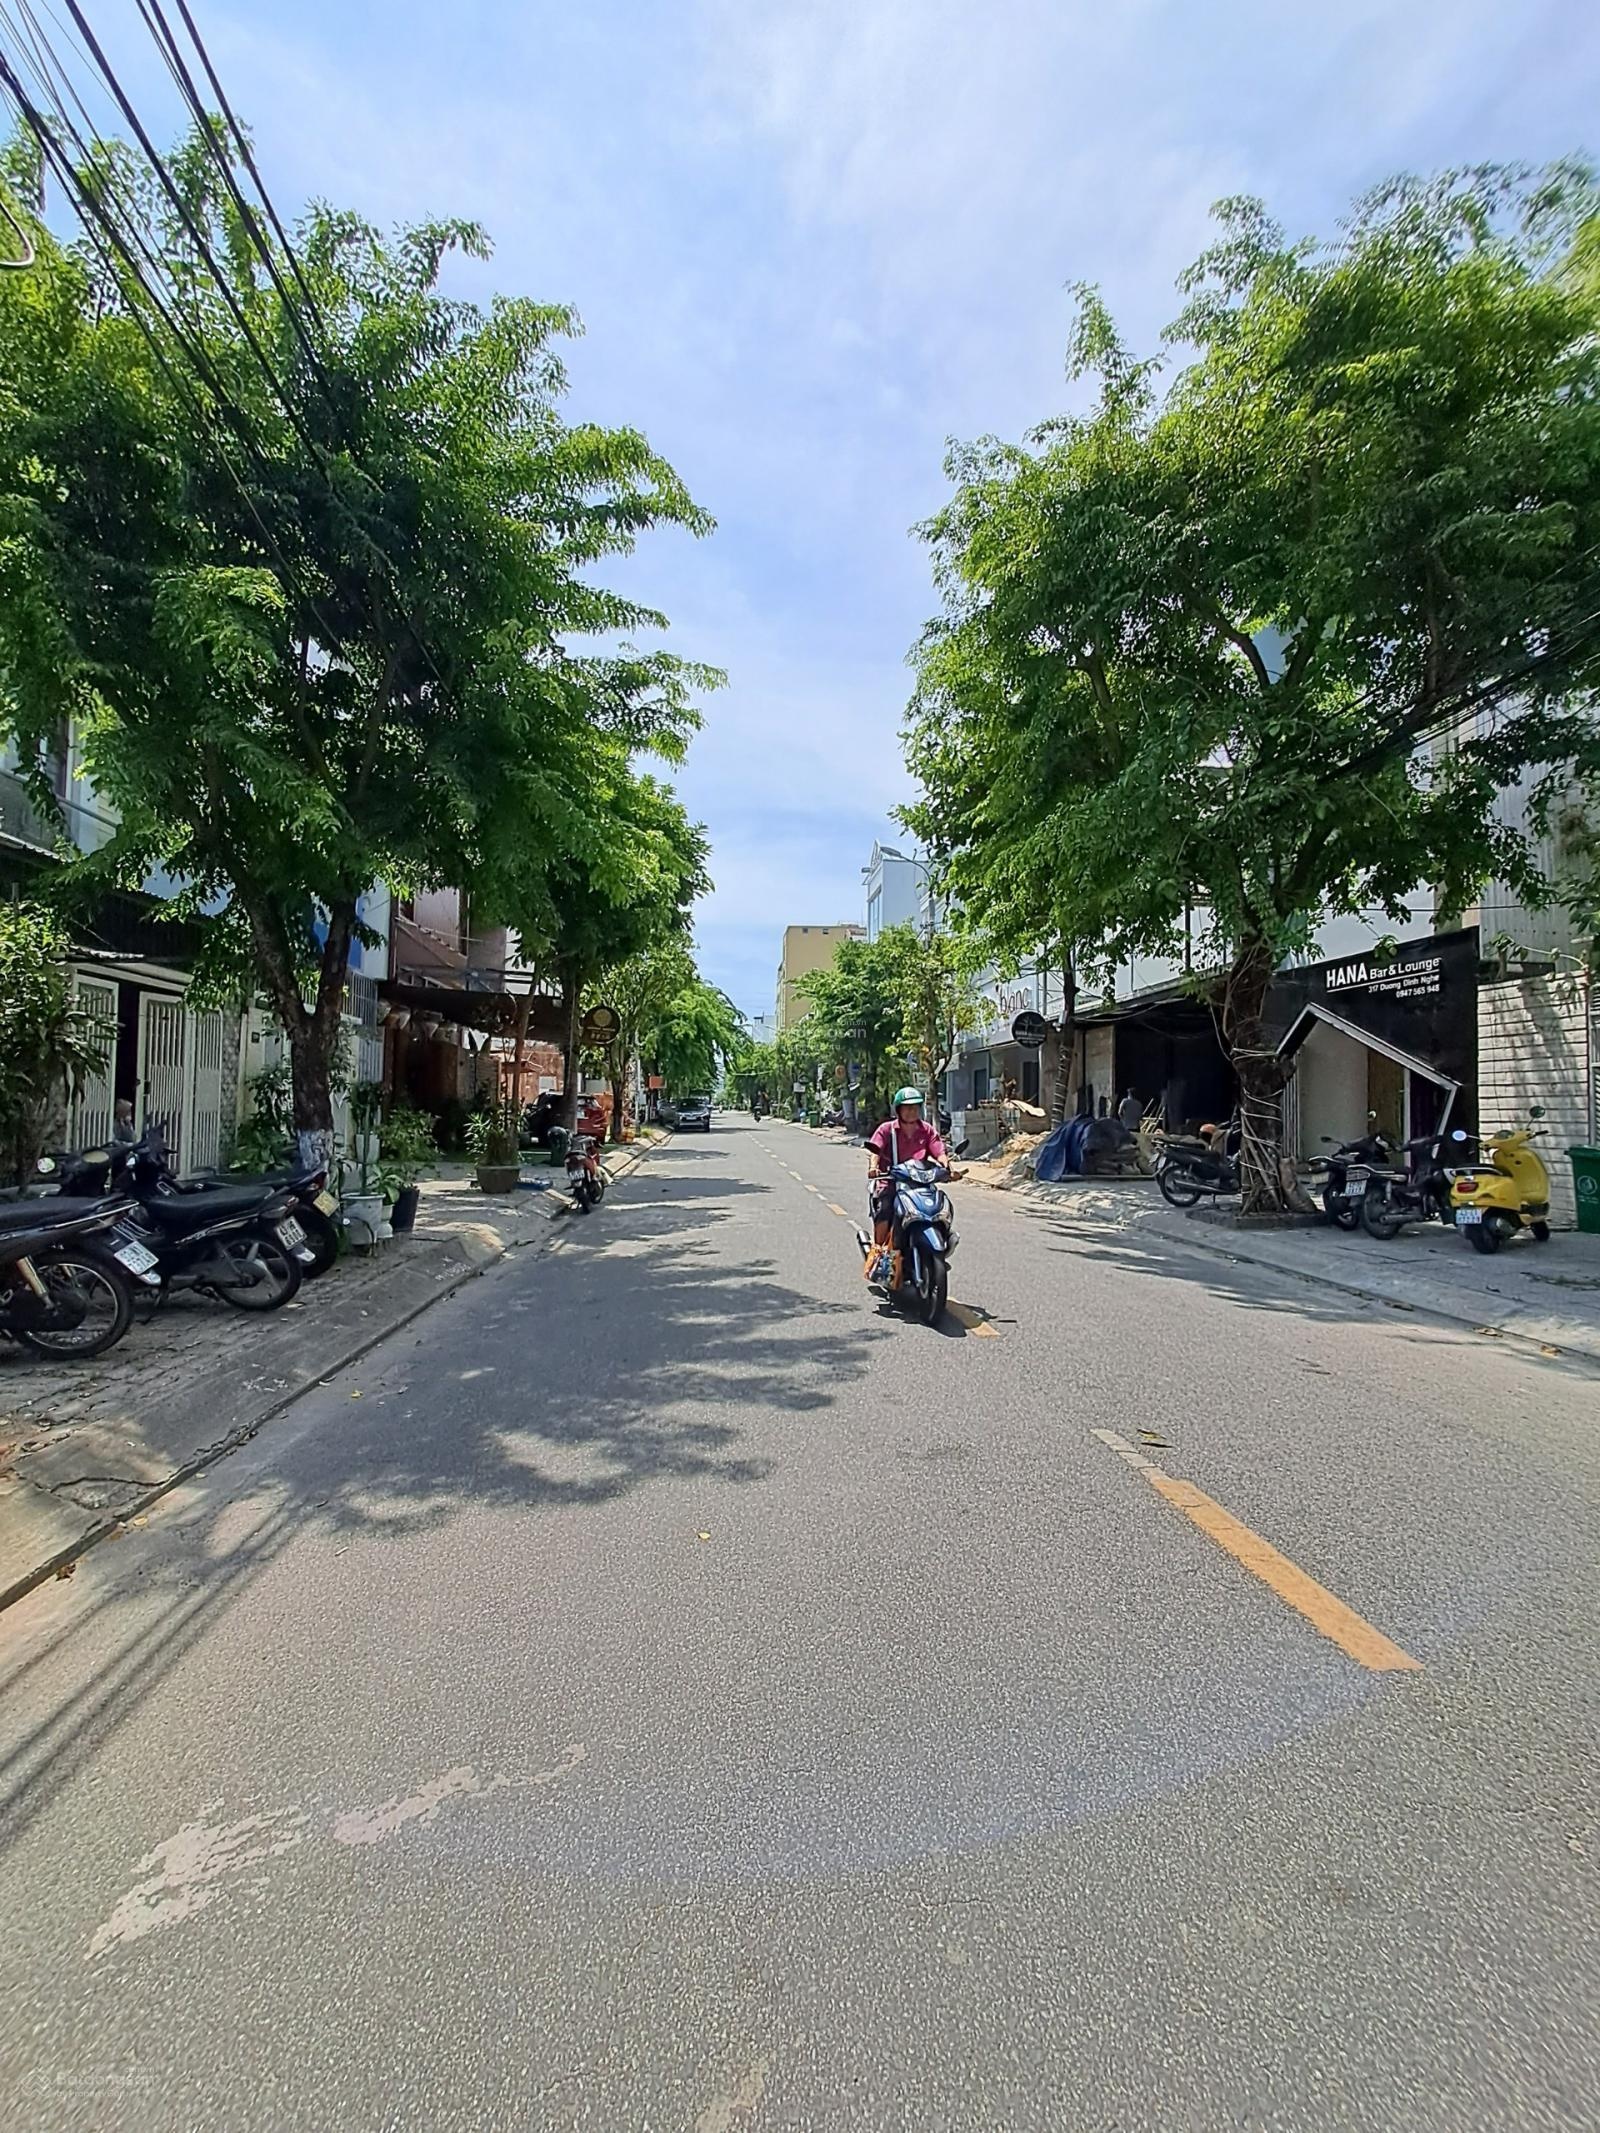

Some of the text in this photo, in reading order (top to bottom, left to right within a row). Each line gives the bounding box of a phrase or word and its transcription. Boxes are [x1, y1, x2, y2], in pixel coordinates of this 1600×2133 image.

[1326, 962, 1368, 988] HANA
[1369, 968, 1388, 980] Bar
[1398, 958, 1442, 974] Lounge
